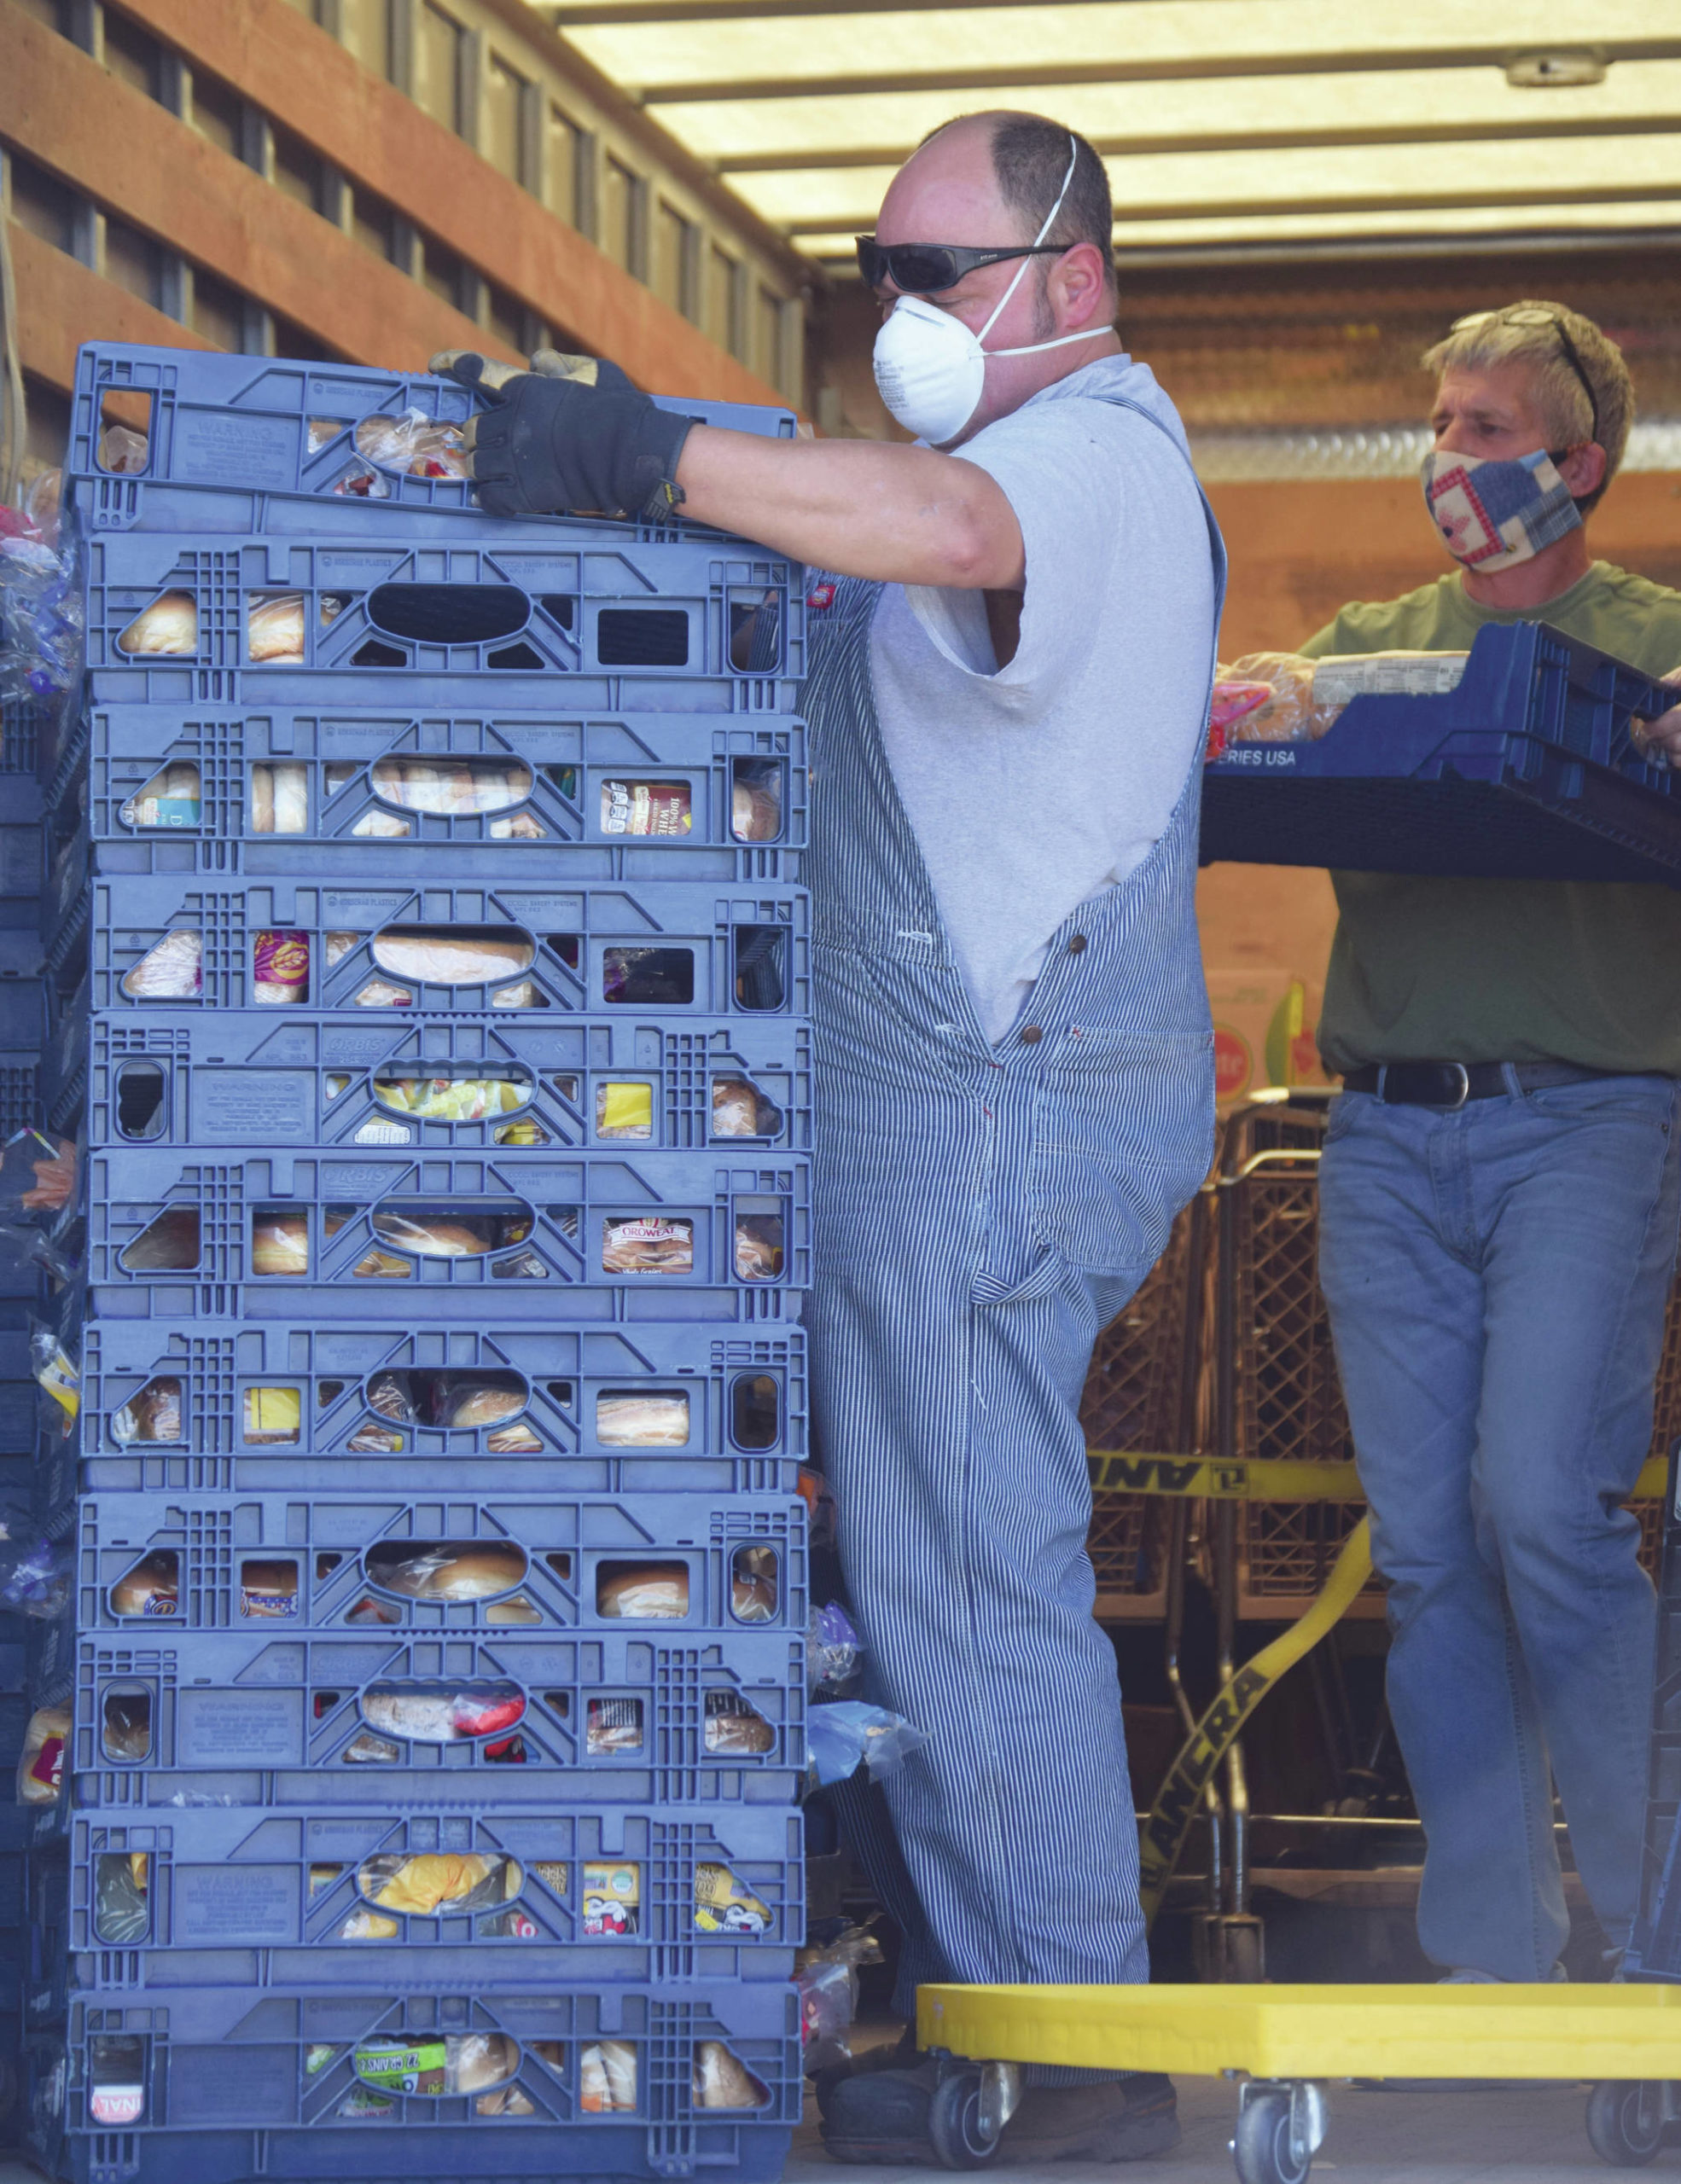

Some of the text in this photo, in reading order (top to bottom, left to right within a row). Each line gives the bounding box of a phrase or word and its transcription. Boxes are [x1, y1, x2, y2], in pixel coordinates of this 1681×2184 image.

[1265, 750, 1296, 766] USA
[669, 797, 680, 825] 100%
[328, 1037, 383, 1052] ORBIS
[212, 1082, 297, 1092] WARNING
[323, 1166, 387, 1183] ORBIS
[622, 1226, 675, 1238] OROWEAT
[198, 1703, 285, 1711] WARNING
[1149, 1665, 1271, 1861] ANCRA
[197, 1876, 274, 1889] WARNING
[367, 2054, 404, 2072] GRAINS
